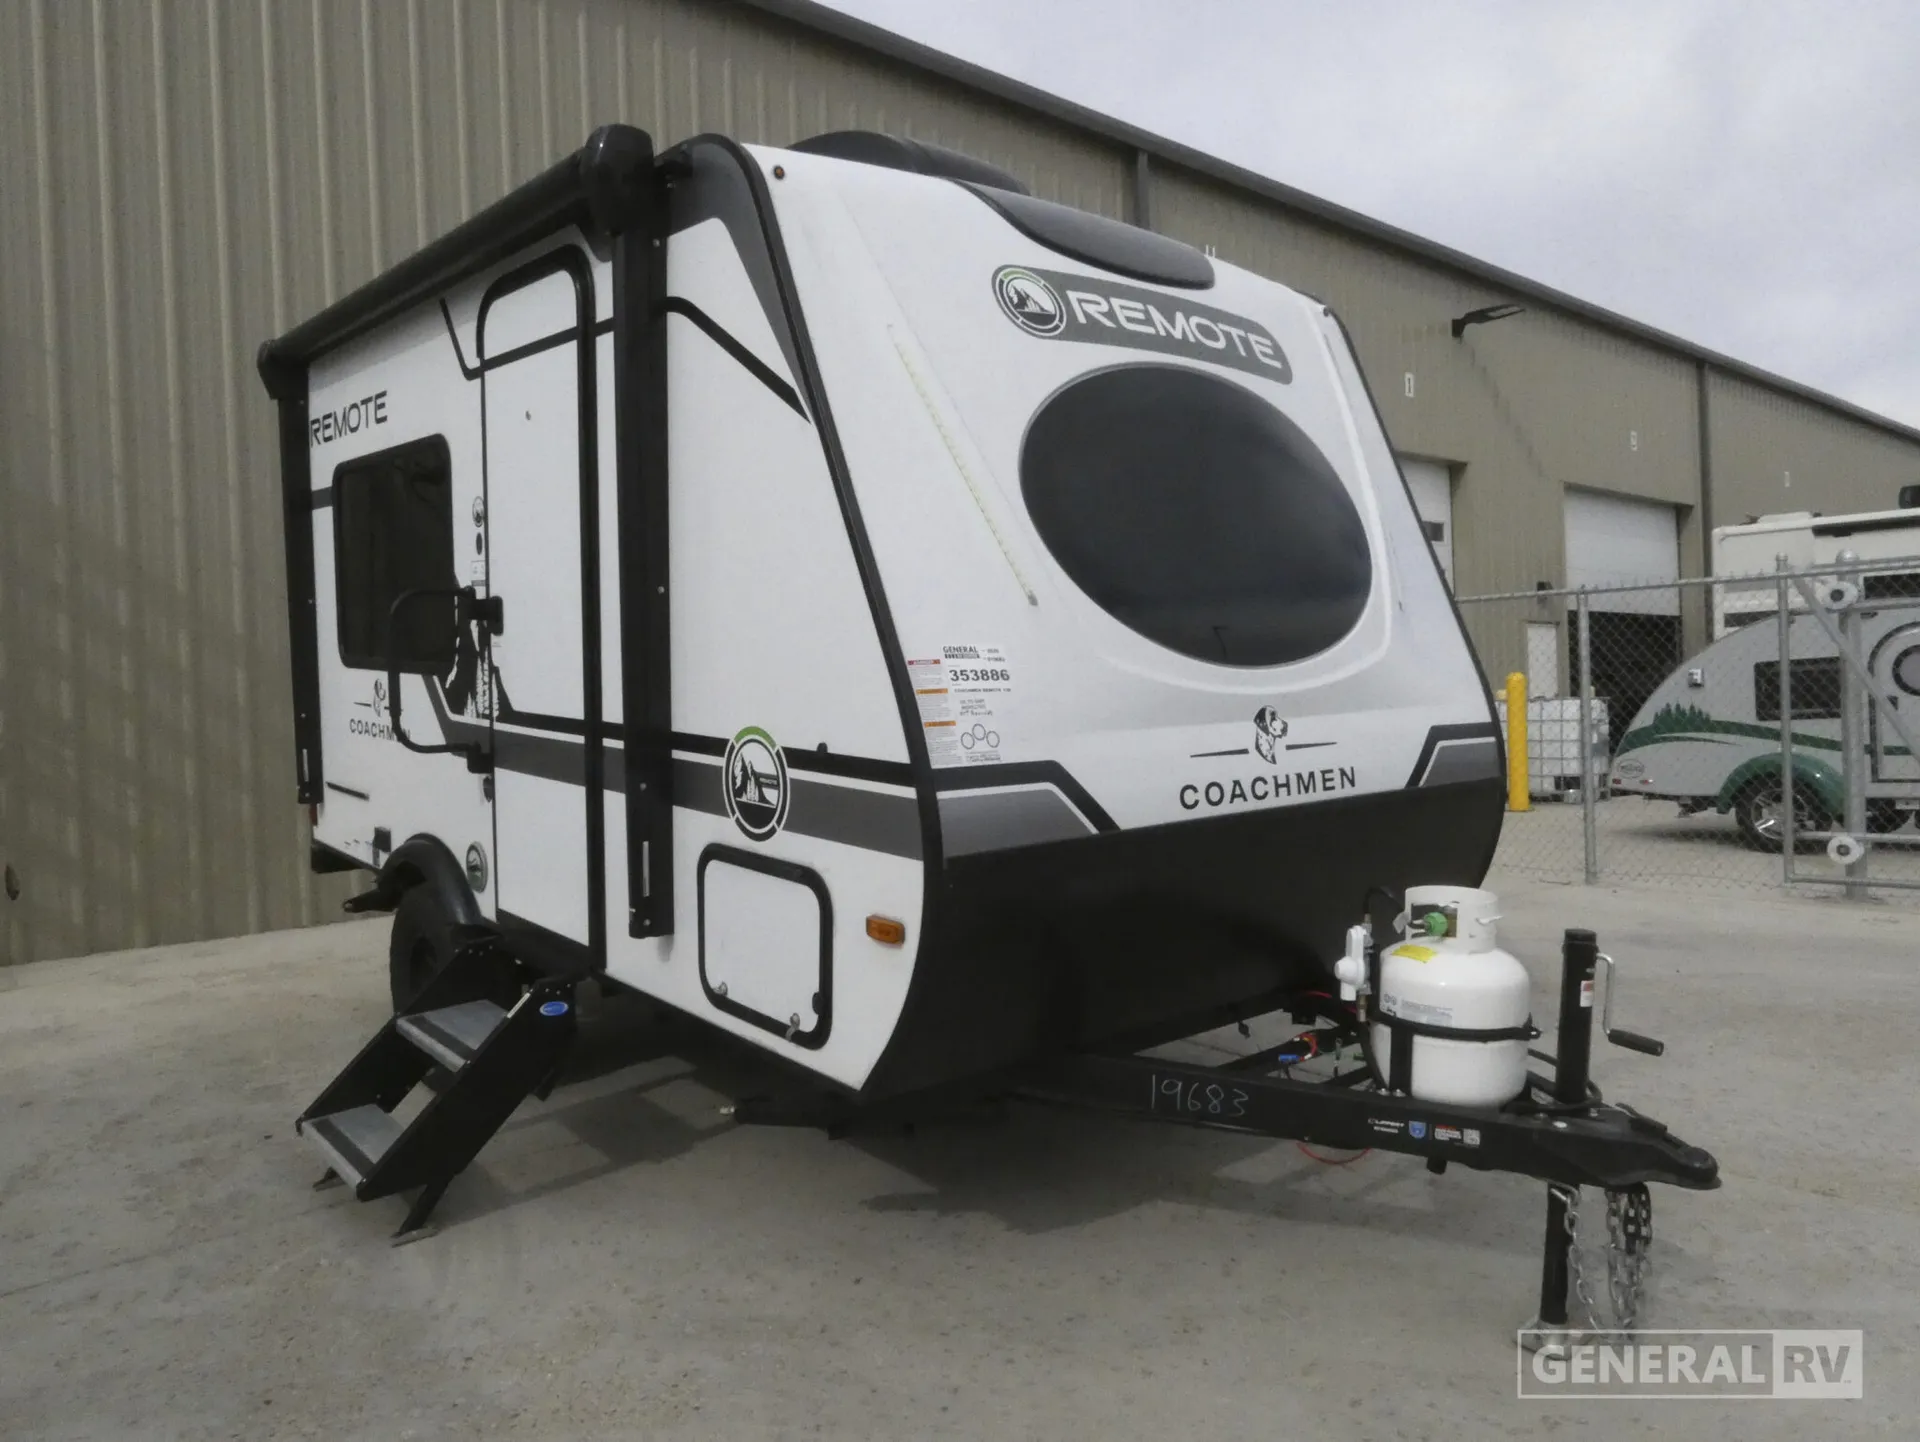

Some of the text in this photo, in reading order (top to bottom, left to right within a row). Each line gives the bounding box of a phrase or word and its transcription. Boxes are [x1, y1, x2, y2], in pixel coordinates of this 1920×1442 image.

[1066, 290, 1282, 369] REMOTE
[309, 390, 388, 448] REMOTE
[942, 646, 978, 654] GENERAL
[949, 669, 1010, 682] 353886
[350, 718, 411, 742] COACHMN
[1179, 766, 1356, 810] COACHMEN
[1151, 1074, 1249, 1117] 19683
